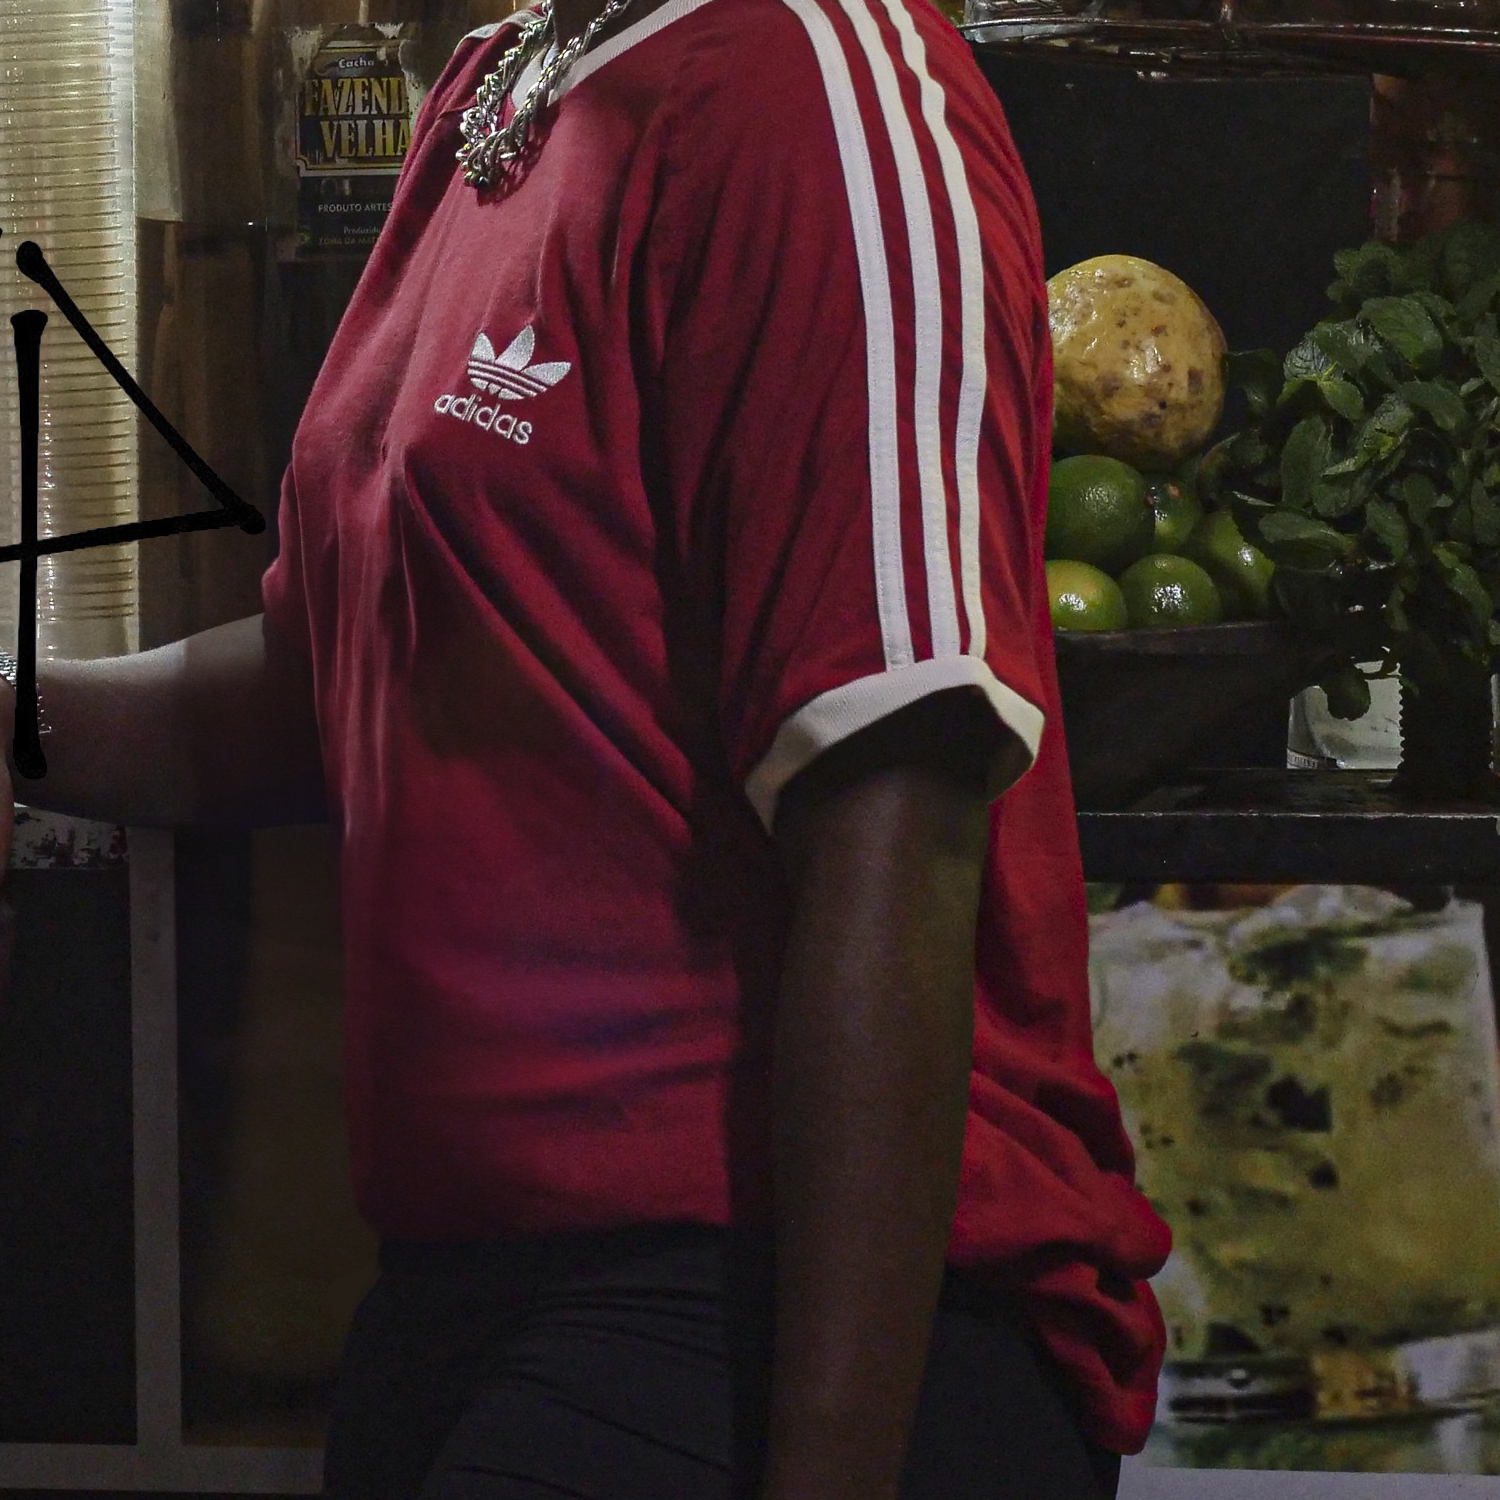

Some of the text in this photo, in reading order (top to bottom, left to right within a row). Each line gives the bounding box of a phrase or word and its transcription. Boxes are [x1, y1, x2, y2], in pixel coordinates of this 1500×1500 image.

[320, 118, 411, 158] VELHA
[318, 202, 363, 213] PRODUTO
[433, 391, 533, 448] adidas
